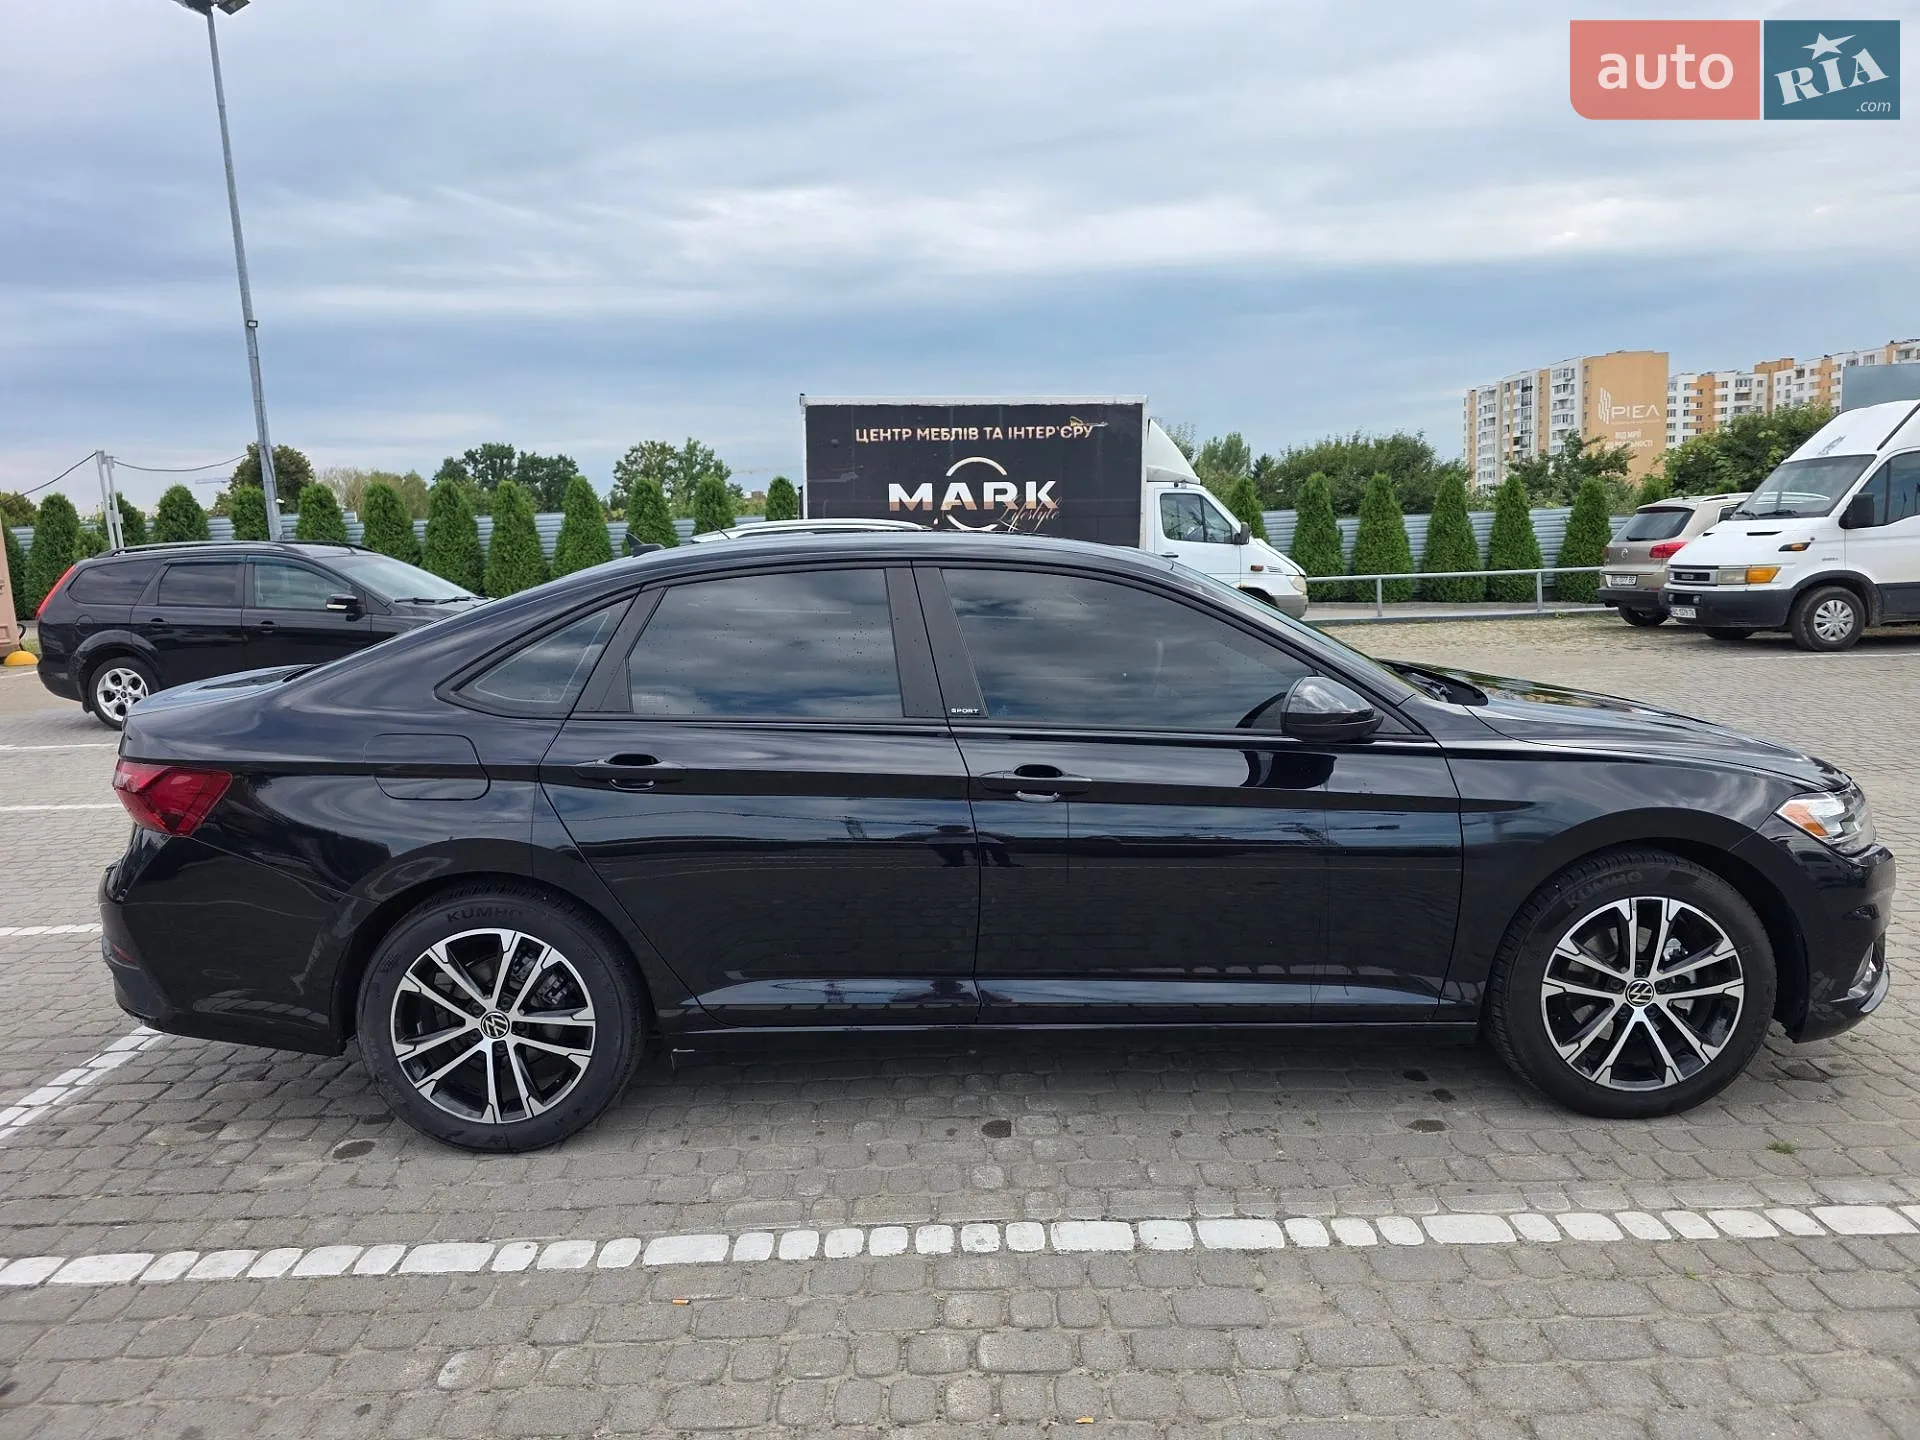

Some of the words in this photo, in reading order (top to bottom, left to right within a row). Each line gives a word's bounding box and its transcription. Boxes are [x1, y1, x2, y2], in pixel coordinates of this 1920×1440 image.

[855, 427, 911, 443] ЦЕНТР
[916, 426, 979, 442] МЕБЛІВ
[983, 426, 1003, 441] ТА
[888, 481, 1059, 512] MARK
[447, 906, 522, 923] KUMHO
